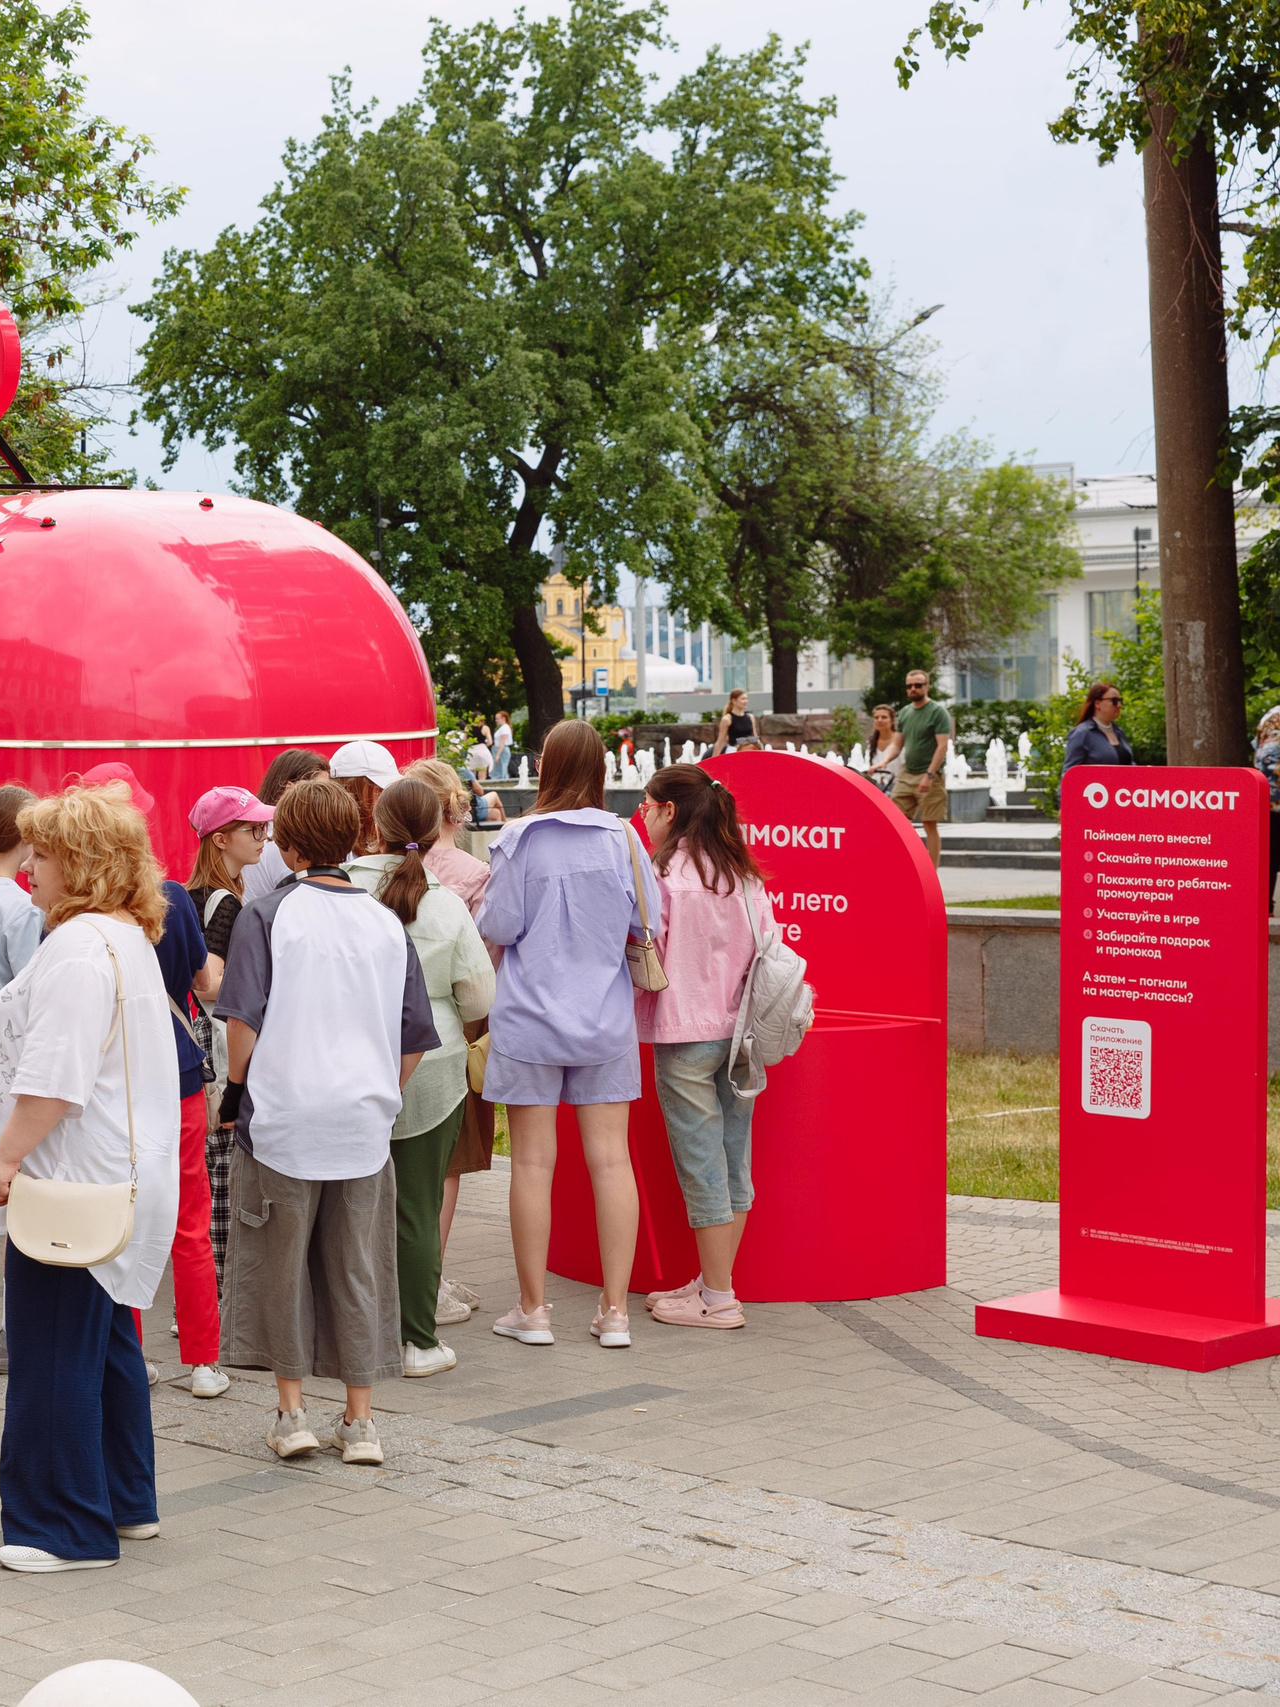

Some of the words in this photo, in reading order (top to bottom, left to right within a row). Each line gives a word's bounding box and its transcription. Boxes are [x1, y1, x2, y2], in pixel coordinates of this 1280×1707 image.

[1115, 789, 1240, 810] самокат
[739, 823, 846, 850] мокат
[1084, 829, 1136, 842] Поймаем
[1137, 833, 1165, 843] лето
[1167, 834, 1212, 845] вместе!
[1097, 851, 1152, 865] Скачайте
[1154, 857, 1229, 868] приложение
[1097, 873, 1154, 887] Покажите
[1156, 879, 1175, 889] его
[1177, 878, 1232, 890] ребятам-
[790, 892, 848, 913] лето
[1096, 888, 1174, 902] промоутерам
[1096, 908, 1162, 923] Участвуйте
[1163, 914, 1170, 922] в
[1173, 916, 1200, 926] игре
[1096, 930, 1158, 945] Забирайте
[1160, 937, 1211, 949] подарок
[1096, 945, 1104, 953] и
[1106, 947, 1162, 959] промокод
[1083, 971, 1092, 982] А
[1093, 974, 1126, 985] затем
[1139, 977, 1188, 989] погнали
[1083, 986, 1097, 996] на
[1099, 989, 1194, 1003] мастер-классы?
[1090, 1023, 1125, 1034] Скачать
[1090, 1035, 1143, 1046] приложение
